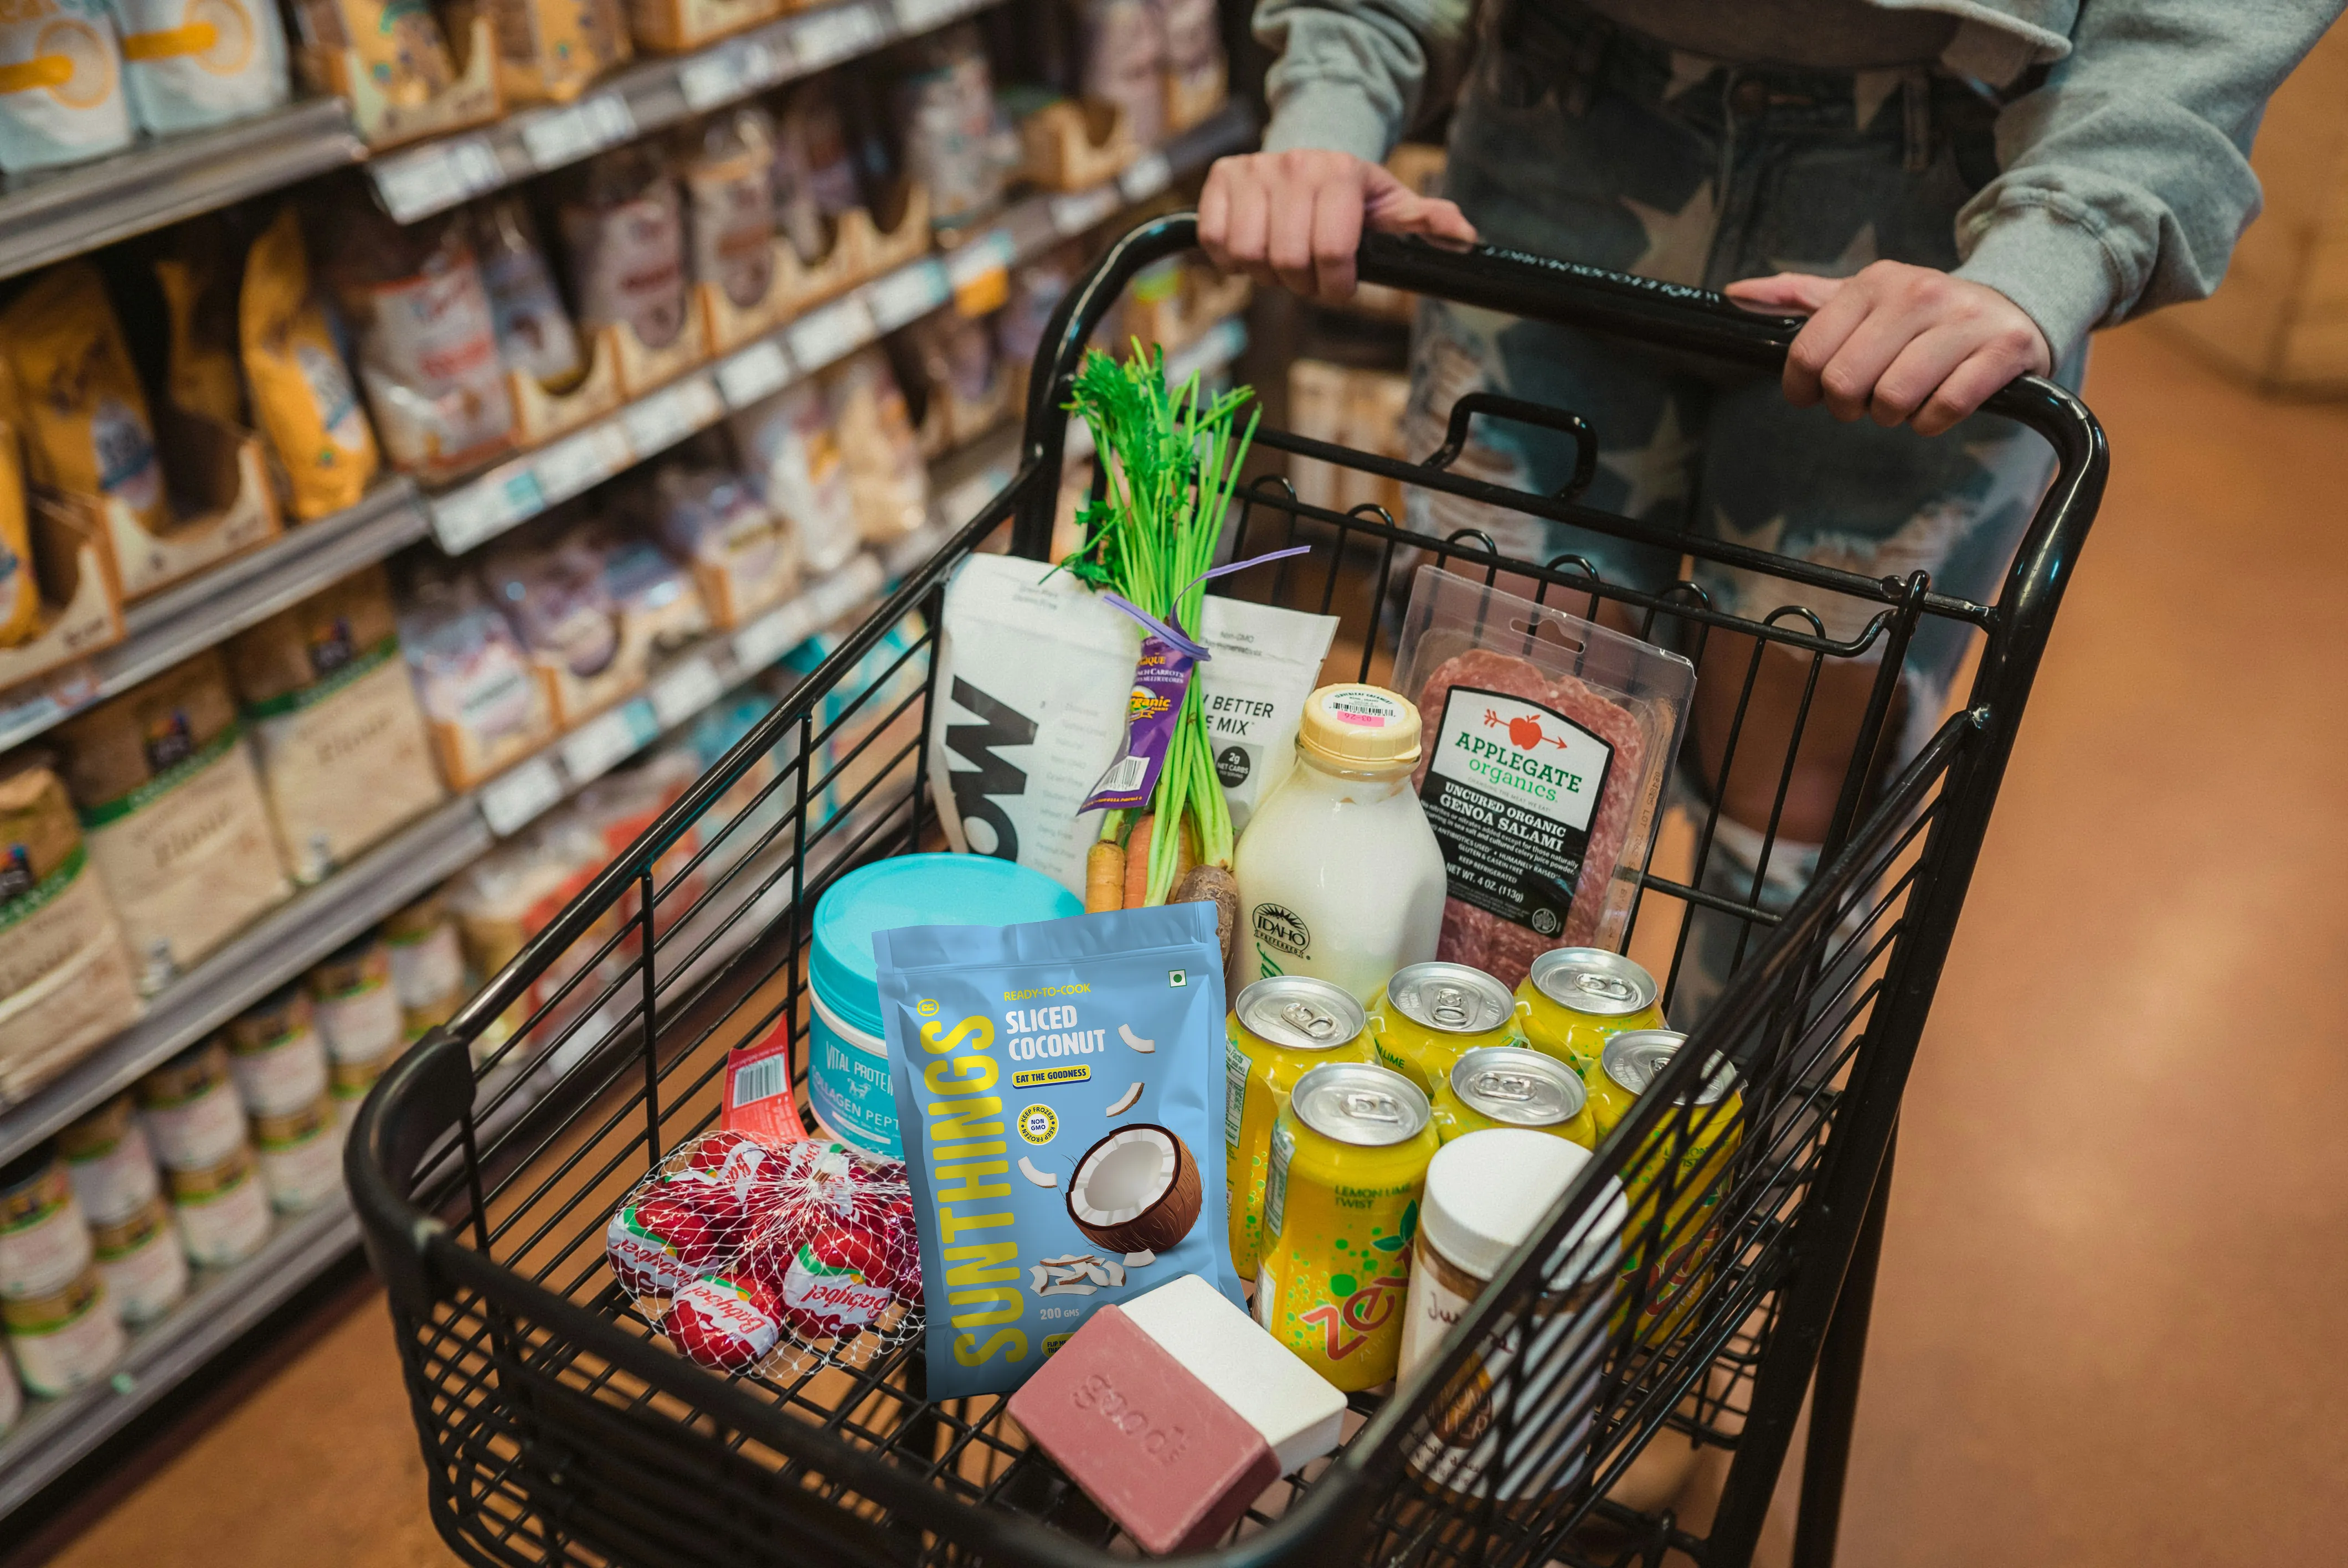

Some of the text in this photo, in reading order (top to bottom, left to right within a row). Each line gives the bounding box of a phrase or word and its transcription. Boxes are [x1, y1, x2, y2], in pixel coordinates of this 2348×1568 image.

[1212, 695, 1274, 718] BETTER
[1217, 718, 1249, 735] MIX
[1228, 752, 1241, 765] 2g
[1228, 764, 1249, 774] CARBS
[1455, 731, 1583, 793] APPLEGATE
[1469, 759, 1557, 801] organics
[1440, 793, 1564, 853] GENOA SALAMI
[1445, 781, 1567, 837] UNCURED ORGANIC
[1640, 809, 1650, 829] LOT
[1429, 804, 1450, 818] nitrites
[1458, 815, 1481, 830] nitrates
[1482, 826, 1501, 838] added
[1501, 834, 1521, 847] except
[1522, 842, 1532, 850] for
[1532, 845, 1549, 858] those
[1551, 853, 1578, 870] naturally
[1437, 827, 1474, 847] ANTIBIOTICS
[1499, 852, 1533, 870] HUMANELY
[1458, 843, 1481, 858] GLUTEN
[1487, 856, 1508, 869] CASEIN
[1509, 865, 1523, 875] FREE
[1477, 832, 1489, 841] and
[1489, 836, 1515, 852] cultured
[1515, 847, 1533, 860] celery
[1533, 854, 1549, 865] juice
[1550, 861, 1574, 875] powder.
[1446, 862, 1523, 903] NET WT. 4 OZ. (113g)
[1459, 855, 1518, 884] KEEP REFRIGERATED
[1257, 915, 1306, 946] IDAHO
[1004, 983, 1091, 1002] READY-TO-COOK
[1006, 1005, 1077, 1034] SLICED
[826, 1041, 850, 1072] VITAL
[1008, 1029, 1105, 1061] COCONUT
[1383, 1049, 1405, 1069] LIME
[1016, 1068, 1087, 1083] EAT THE GOODNESS
[1021, 1107, 1054, 1122] KEEP FROZEN
[1022, 1126, 1055, 1142] KEEP FROZEN
[1335, 1185, 1383, 1198] LEMON
[1335, 1196, 1374, 1210] TWIST
[690, 1285, 768, 1335] Babybel
[801, 1283, 889, 1321] Babybel
[1040, 1307, 1079, 1320] 200 GMS
